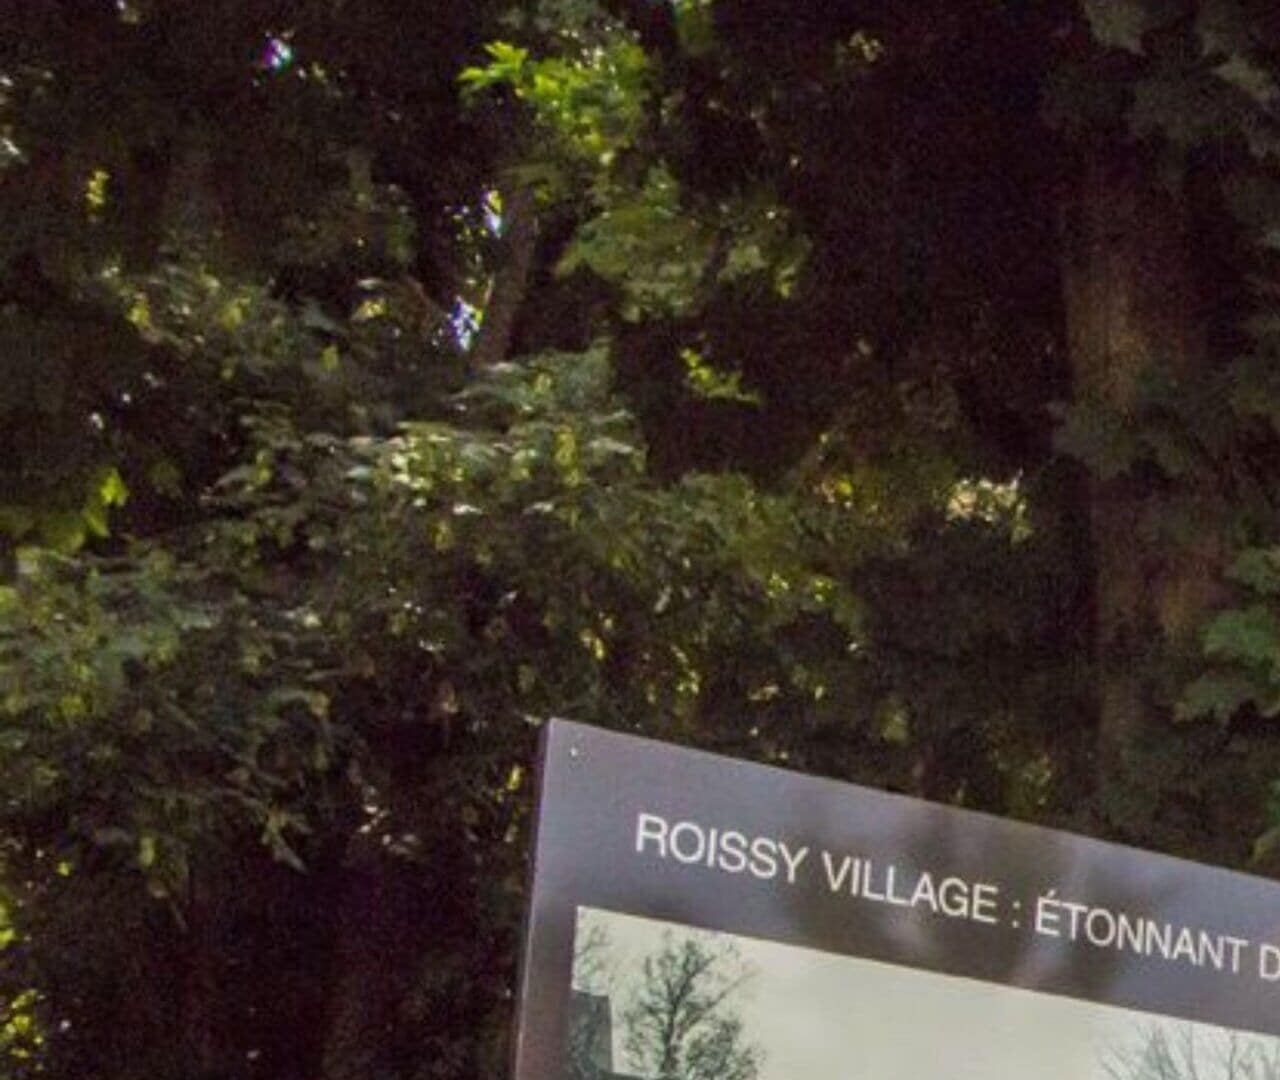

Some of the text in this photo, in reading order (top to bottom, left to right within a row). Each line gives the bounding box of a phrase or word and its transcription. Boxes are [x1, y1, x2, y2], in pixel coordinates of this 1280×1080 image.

[635, 813, 808, 884] ROISSY
[821, 852, 999, 923] VILLAGE
[1034, 889, 1250, 973] ÉTONNANT
